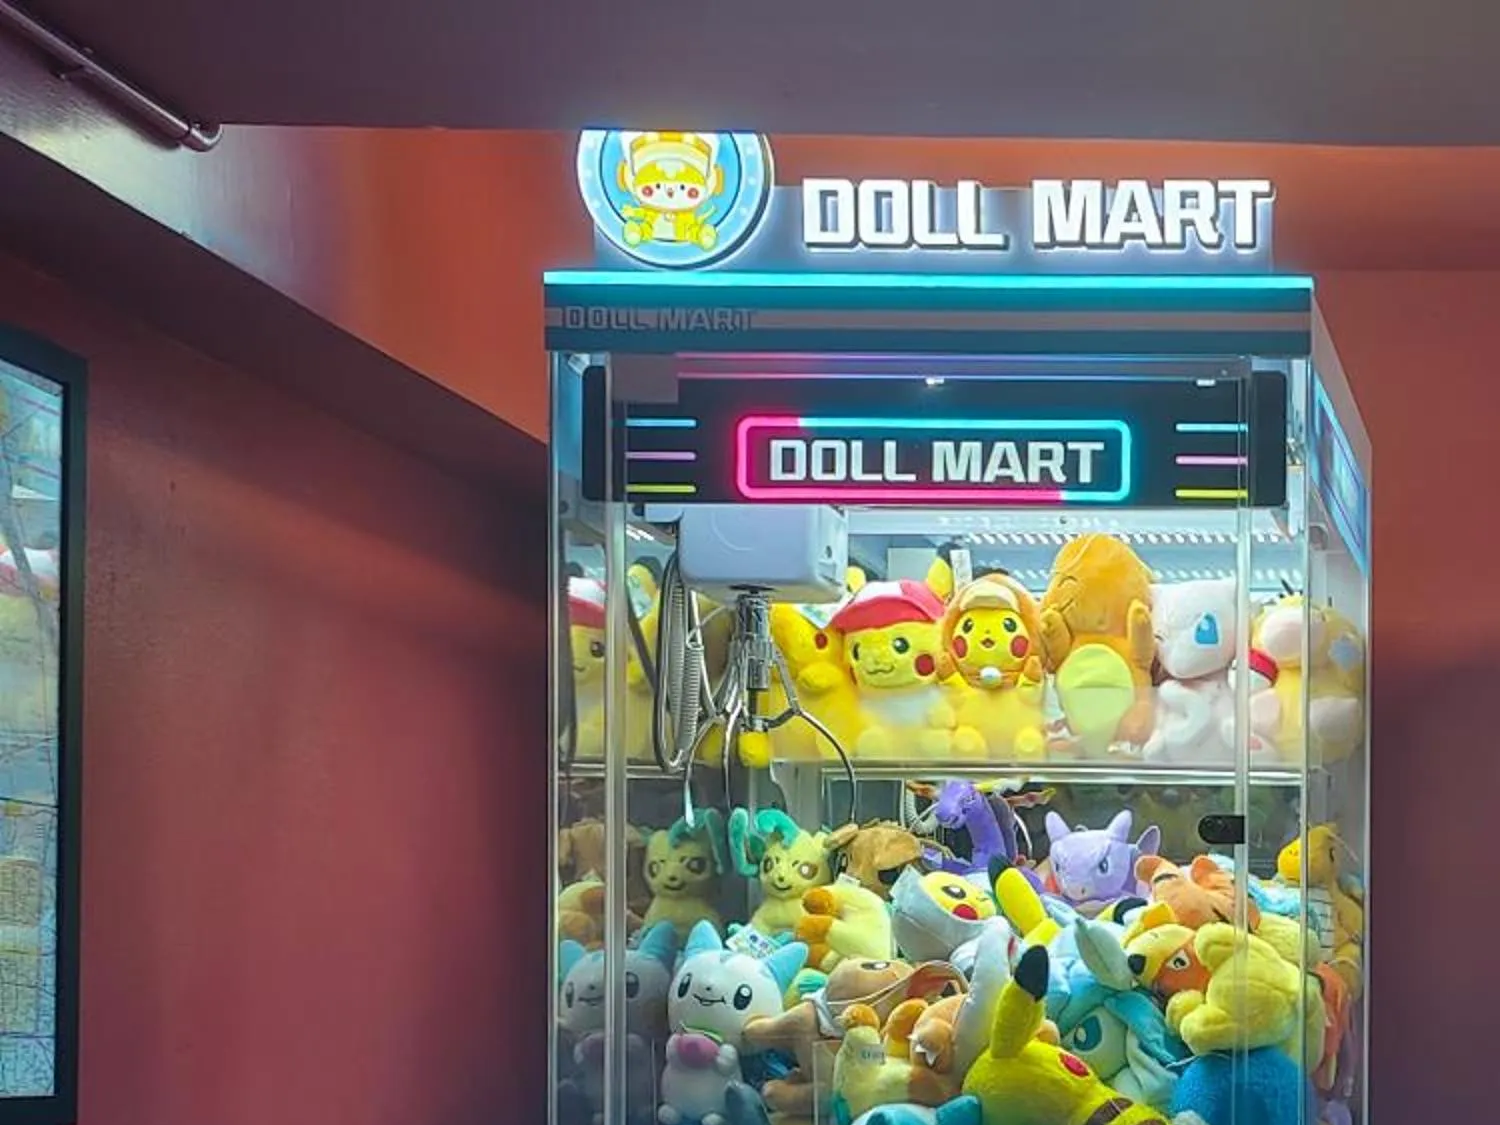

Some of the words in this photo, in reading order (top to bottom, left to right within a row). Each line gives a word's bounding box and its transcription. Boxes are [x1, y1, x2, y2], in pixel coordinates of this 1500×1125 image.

[802, 177, 1007, 249] DOLL
[1031, 177, 1275, 249] MART
[562, 305, 649, 332] DOLL
[656, 305, 757, 333] MART
[769, 439, 917, 484] DOLL
[930, 440, 1105, 485] MART
